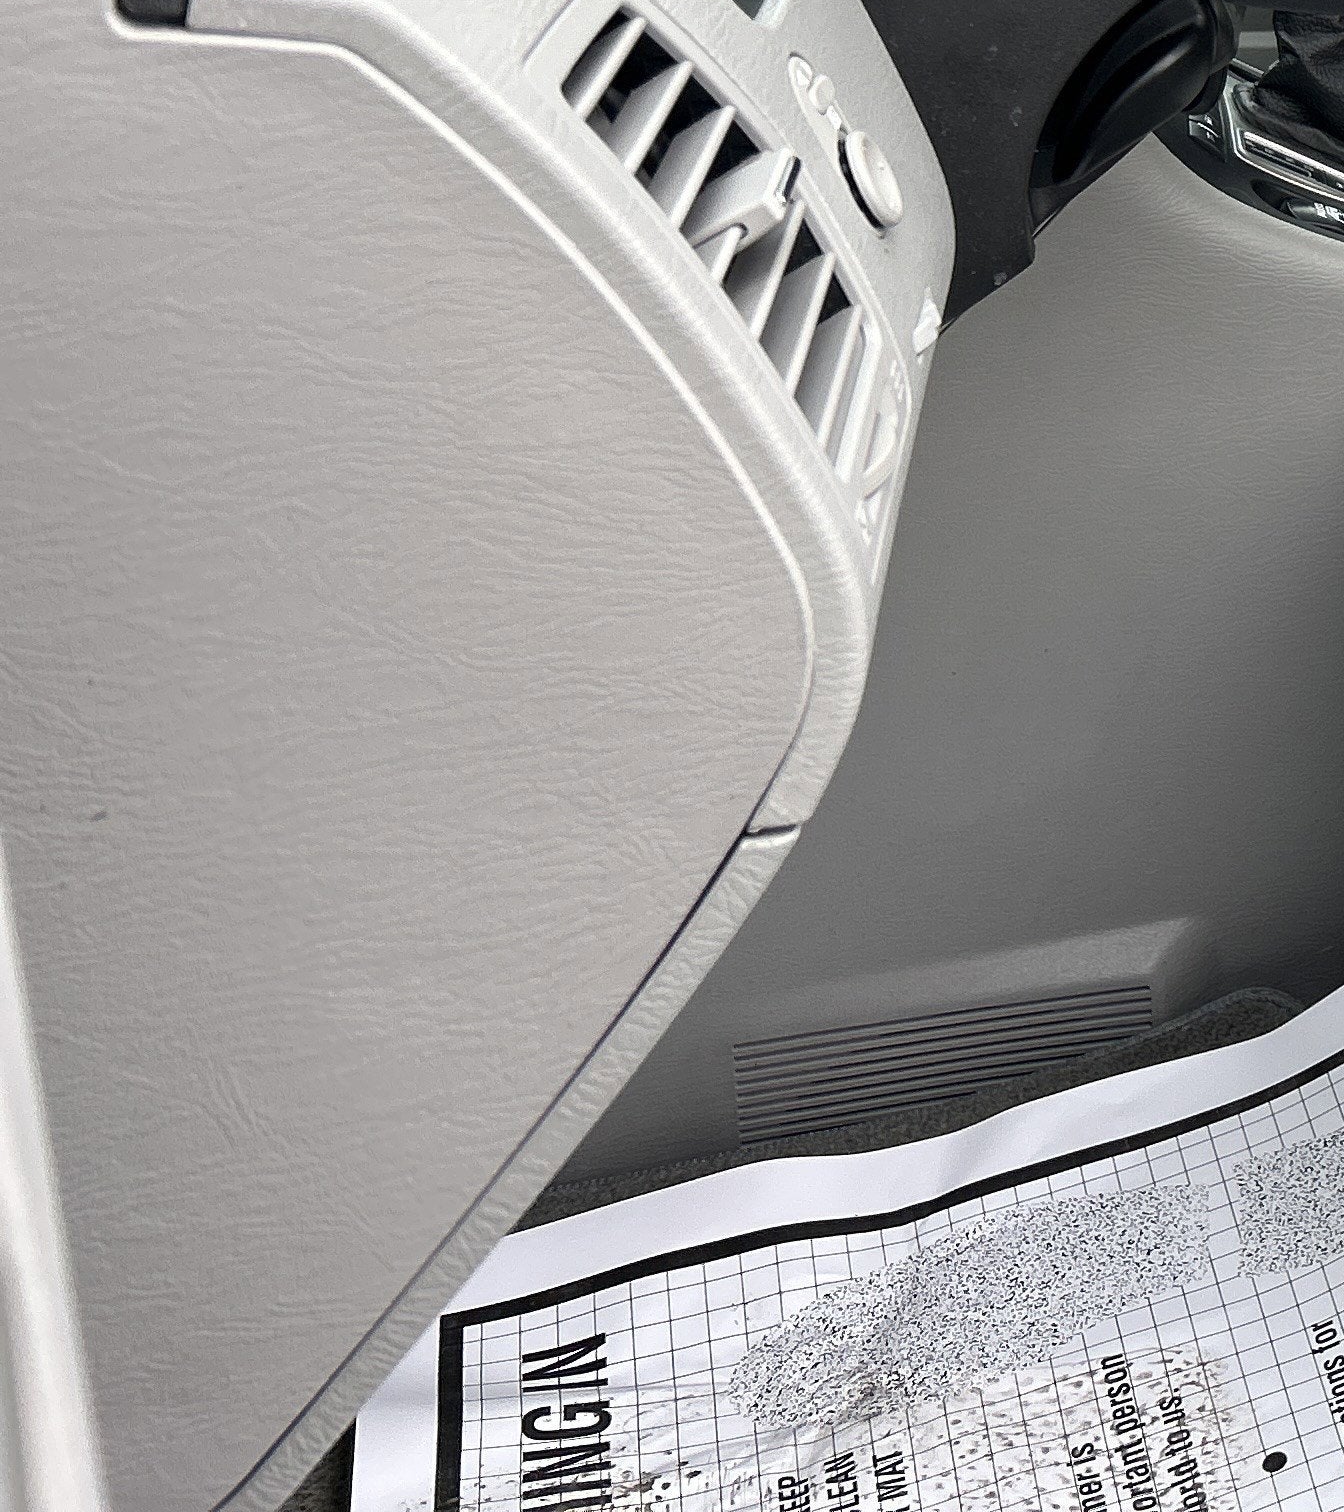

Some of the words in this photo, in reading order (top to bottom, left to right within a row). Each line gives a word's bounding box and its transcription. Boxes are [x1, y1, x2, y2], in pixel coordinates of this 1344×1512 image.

[1310, 1320, 1341, 1355] for
[1101, 1353, 1146, 1437] person
[1159, 1387, 1186, 1426] us.
[1066, 1443, 1097, 1467] is
[1165, 1428, 1193, 1457] to
[778, 1476, 811, 1512] EEP
[824, 1452, 859, 1512] LEAN
[872, 1450, 908, 1503] MAT
[1114, 1437, 1158, 1512] ortant
[1167, 1457, 1208, 1512] orld
